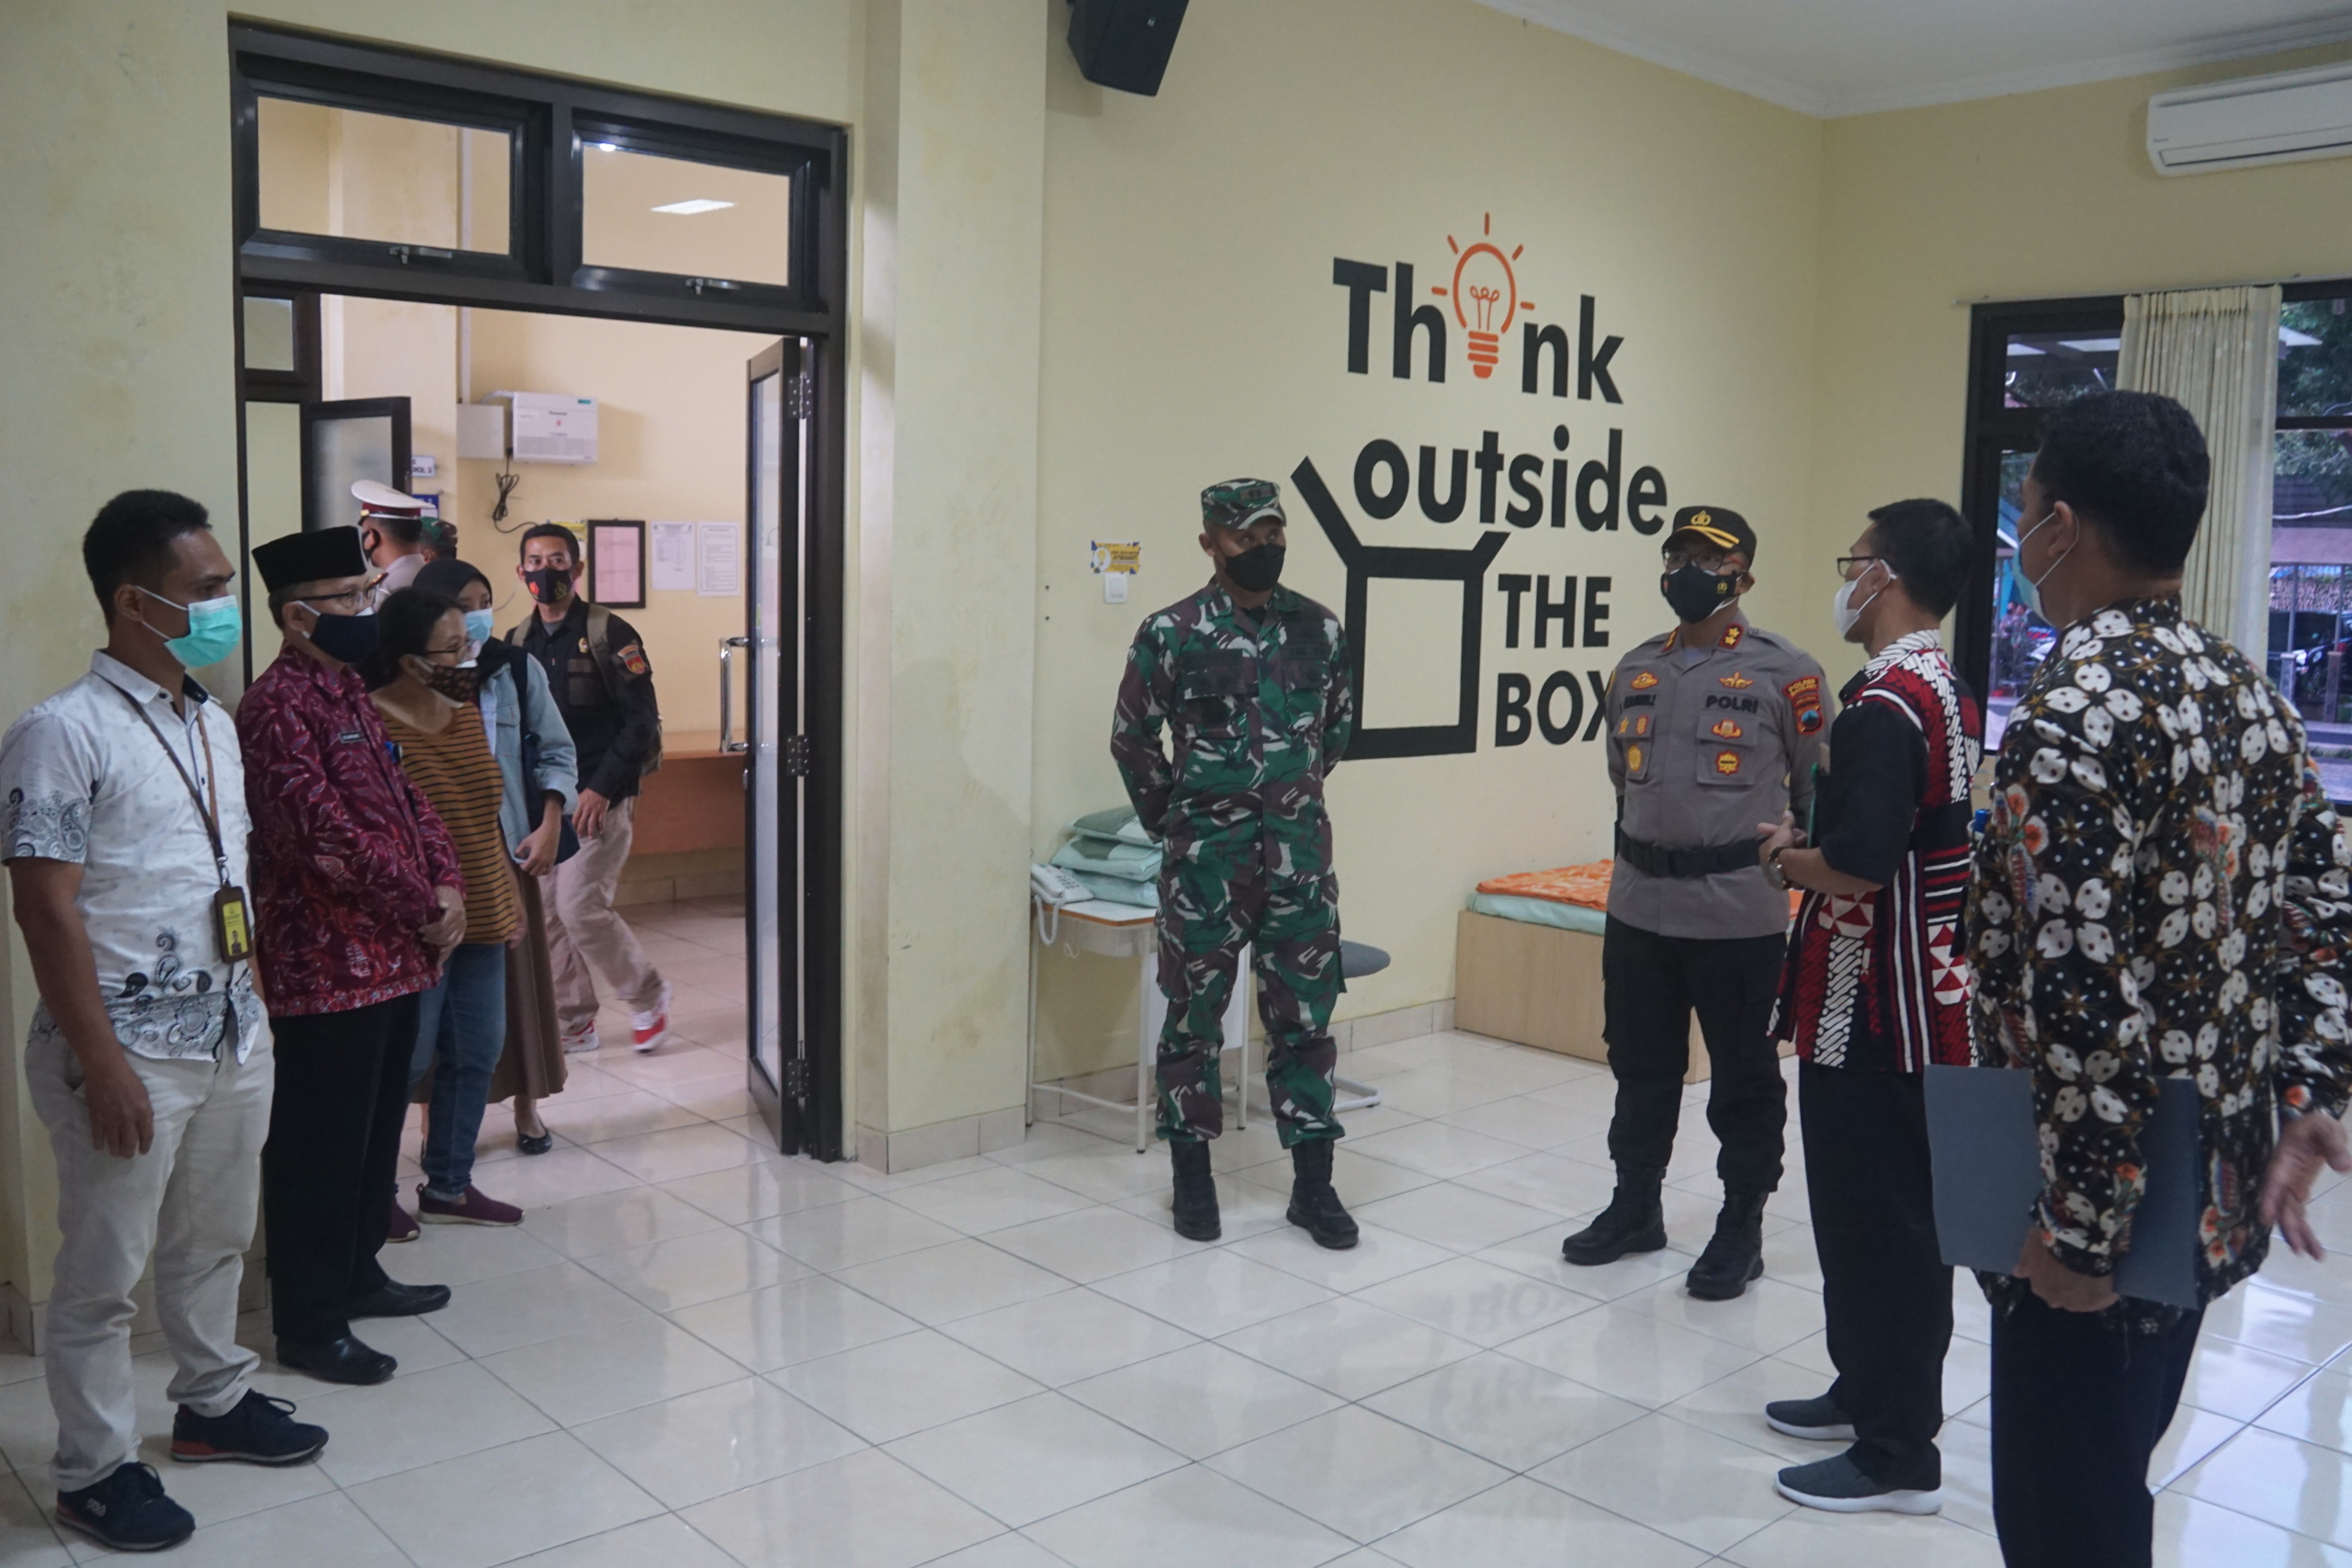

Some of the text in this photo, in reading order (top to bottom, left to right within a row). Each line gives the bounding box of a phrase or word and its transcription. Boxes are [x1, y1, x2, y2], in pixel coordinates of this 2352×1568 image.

[1353, 424, 1668, 536] outside
[1498, 573, 1611, 649] THE
[1495, 670, 1607, 748] BOX
[1706, 694, 1758, 714] POLRI
